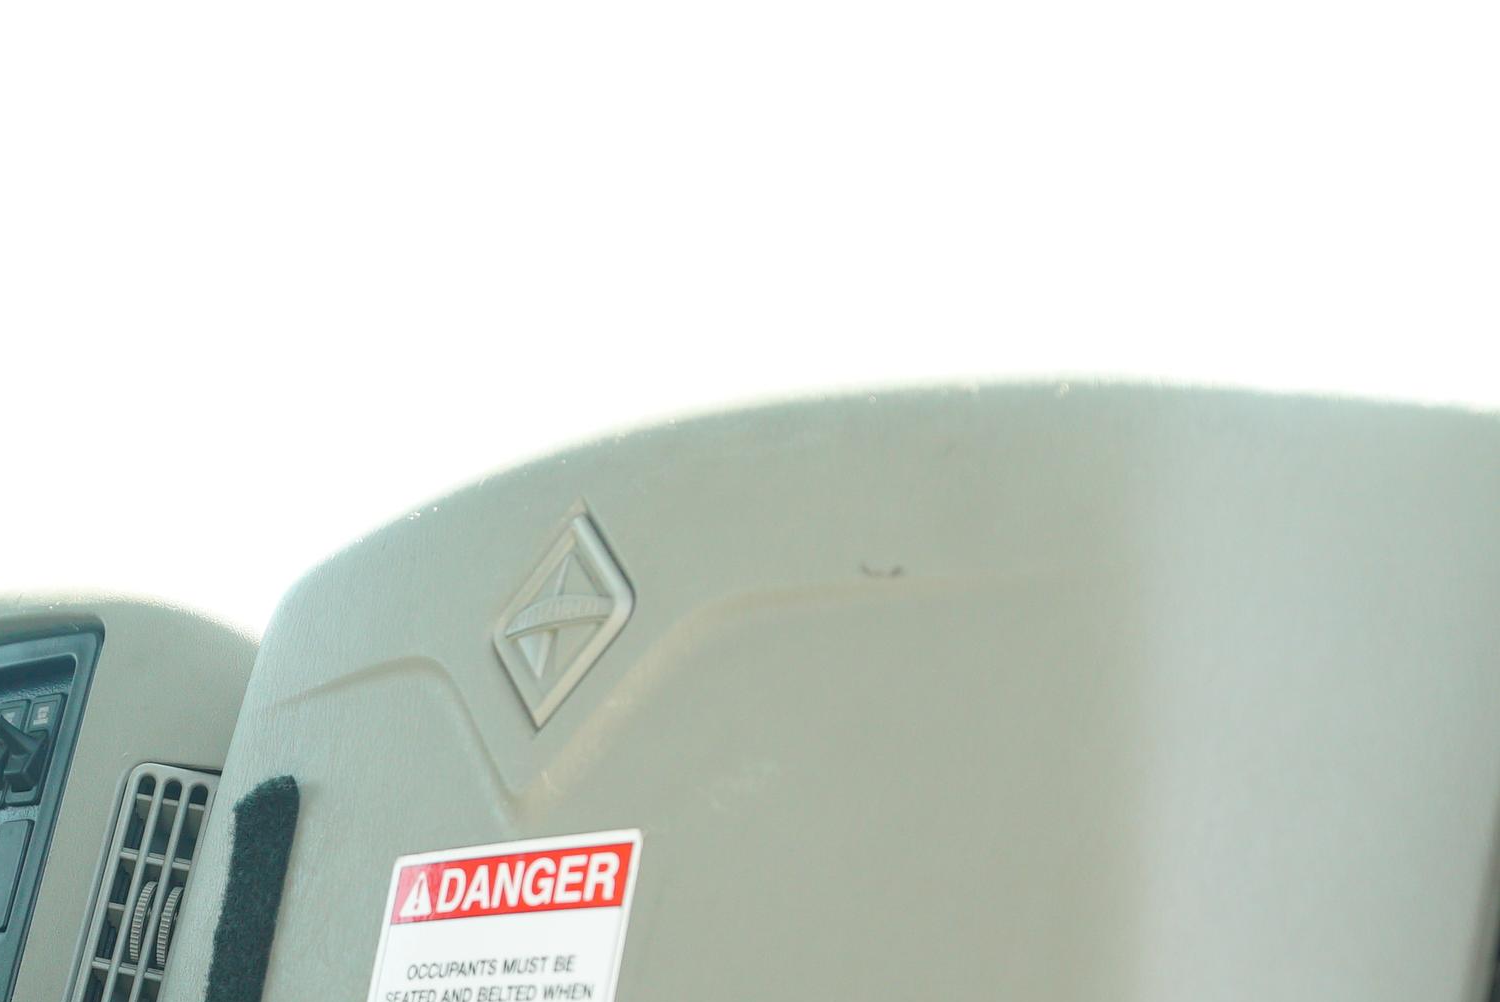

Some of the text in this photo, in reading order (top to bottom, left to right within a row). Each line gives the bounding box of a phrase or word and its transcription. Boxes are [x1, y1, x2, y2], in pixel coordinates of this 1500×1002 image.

[436, 852, 620, 914] DANGER
[406, 955, 577, 981] OCCUPANTS MUST BE
[476, 984, 538, 1002] BELTED
[544, 982, 595, 1001] WHEN
